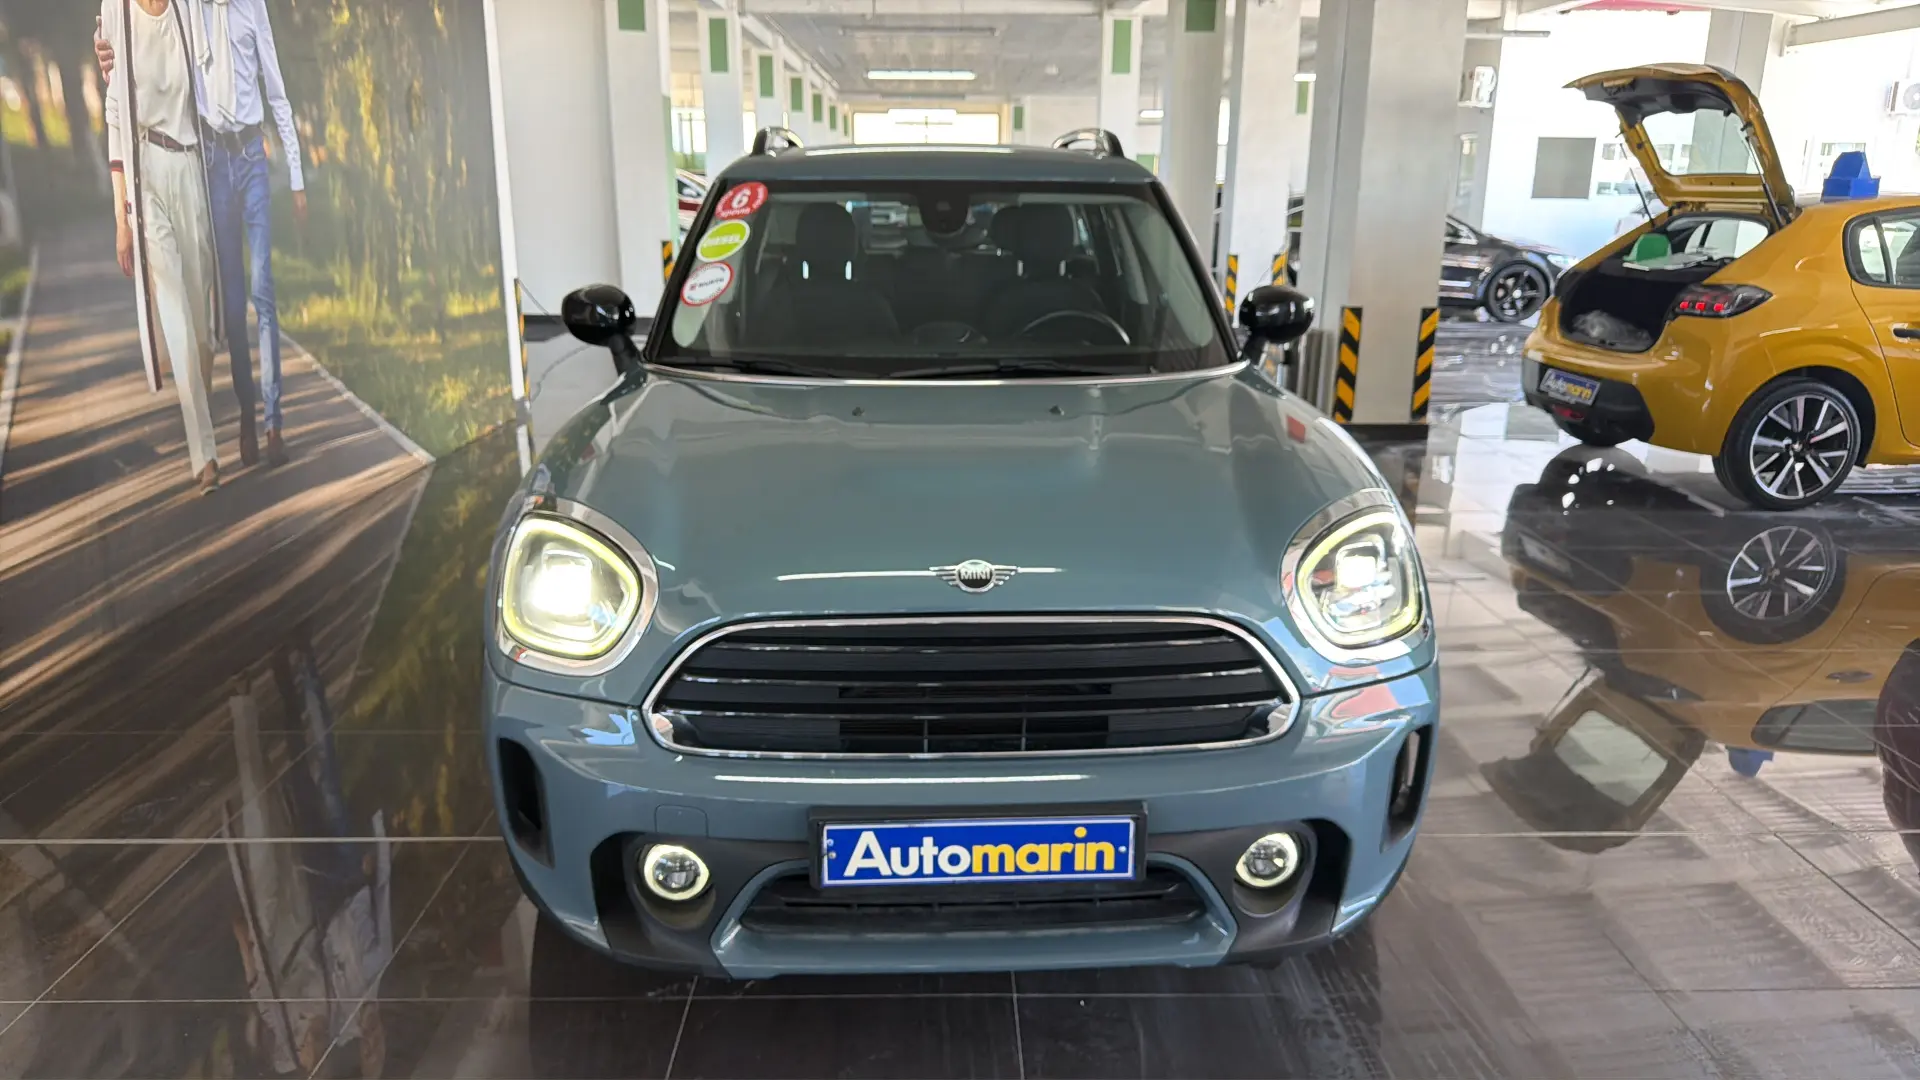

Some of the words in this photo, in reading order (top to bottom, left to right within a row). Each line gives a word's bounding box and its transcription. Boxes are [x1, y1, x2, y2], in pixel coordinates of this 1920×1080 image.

[731, 187, 752, 209] 6
[960, 567, 991, 581] MINI
[843, 826, 1115, 877] Automarin
